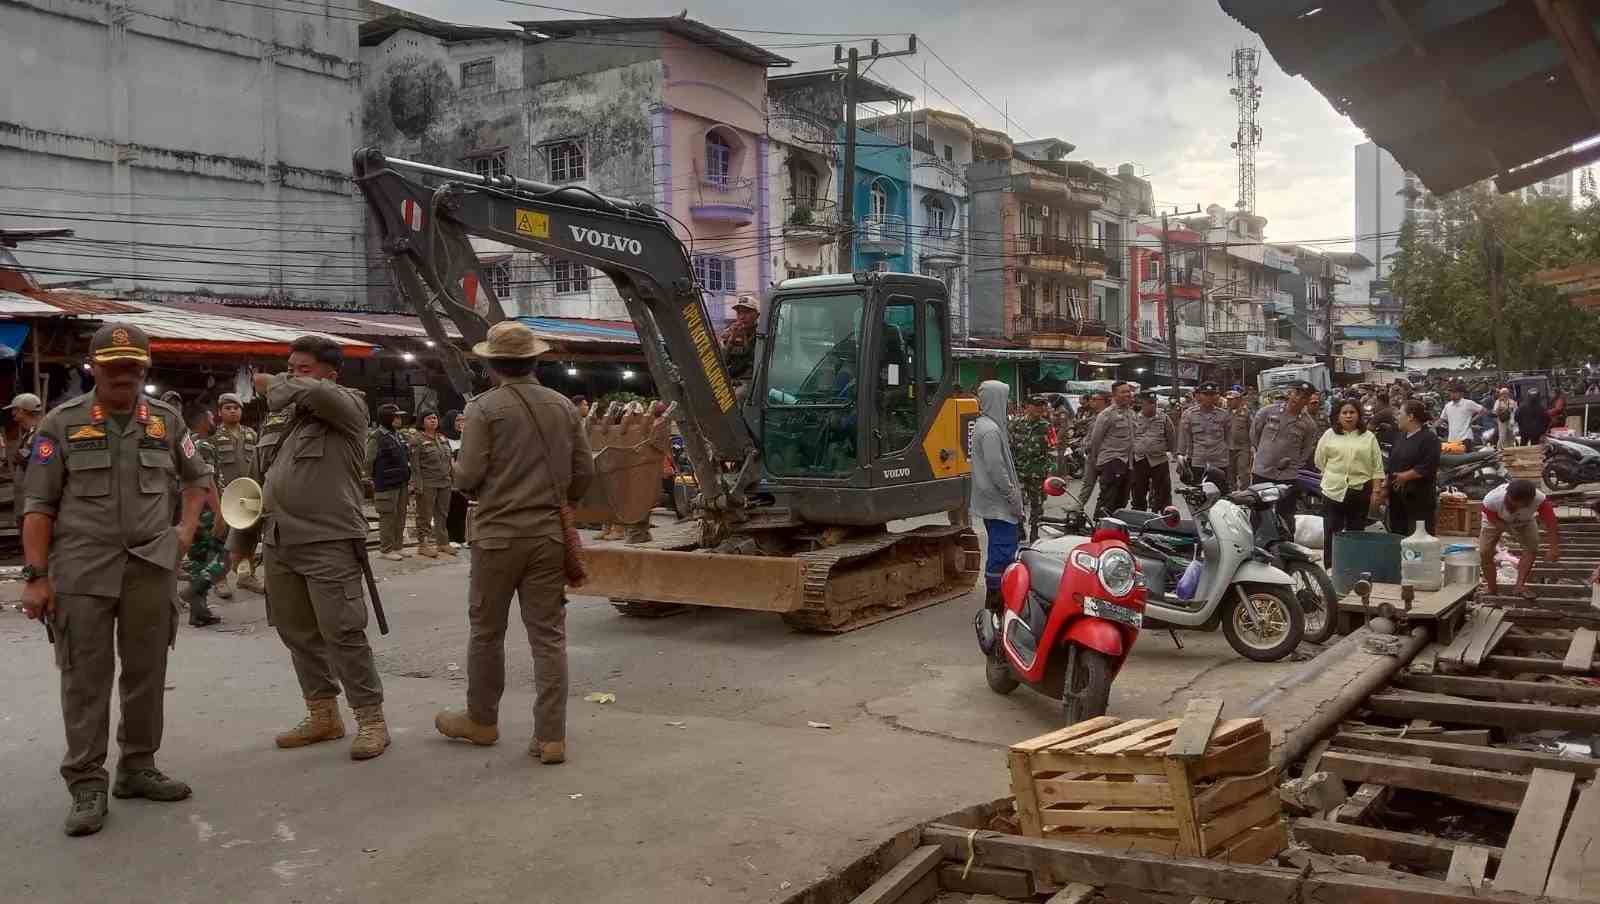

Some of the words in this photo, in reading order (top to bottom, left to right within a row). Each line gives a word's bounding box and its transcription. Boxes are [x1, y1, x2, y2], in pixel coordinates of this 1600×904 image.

[568, 224, 642, 256] VOLVO
[689, 324, 711, 356] KOTA
[700, 351, 737, 414] BALIKPAPAN
[883, 467, 911, 479] VOLVO
